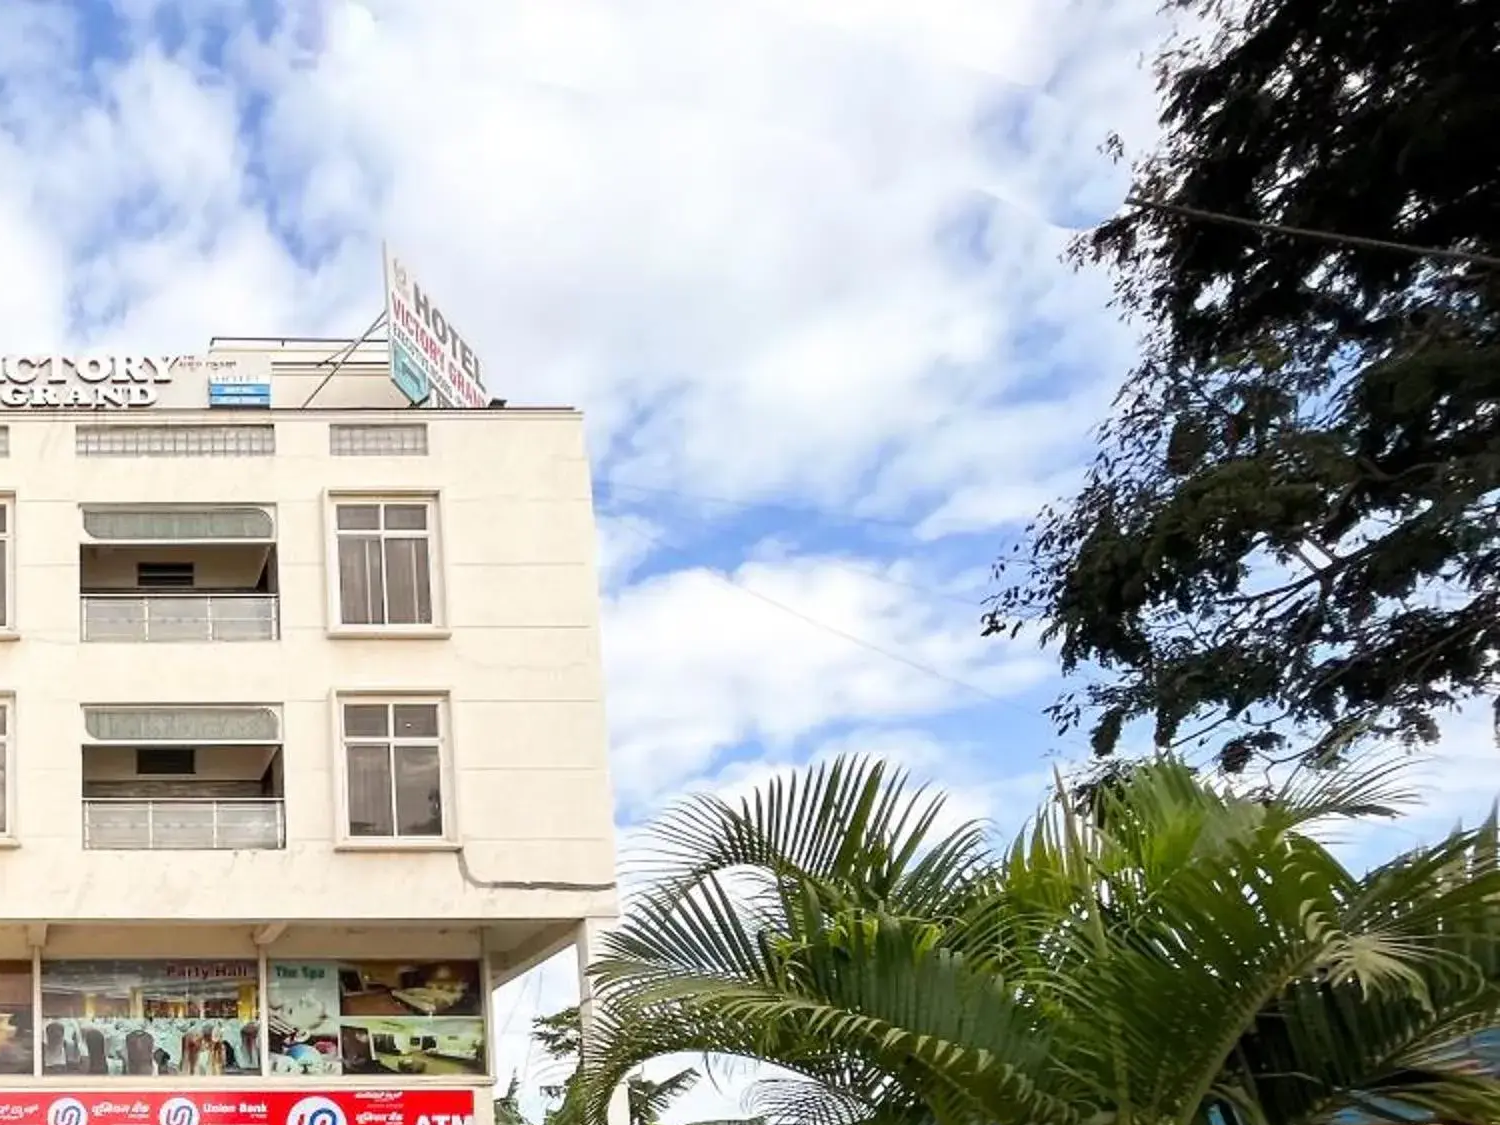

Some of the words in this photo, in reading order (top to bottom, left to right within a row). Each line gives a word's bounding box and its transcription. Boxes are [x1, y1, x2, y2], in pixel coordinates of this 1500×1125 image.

[413, 282, 487, 393] HOTEL
[0, 383, 157, 407] GRAND
[166, 965, 209, 979] Party
[215, 965, 248, 977] Hall
[275, 965, 298, 978] The
[301, 965, 326, 980] Spa
[203, 1103, 236, 1113] Union
[239, 1101, 268, 1113] Bank
